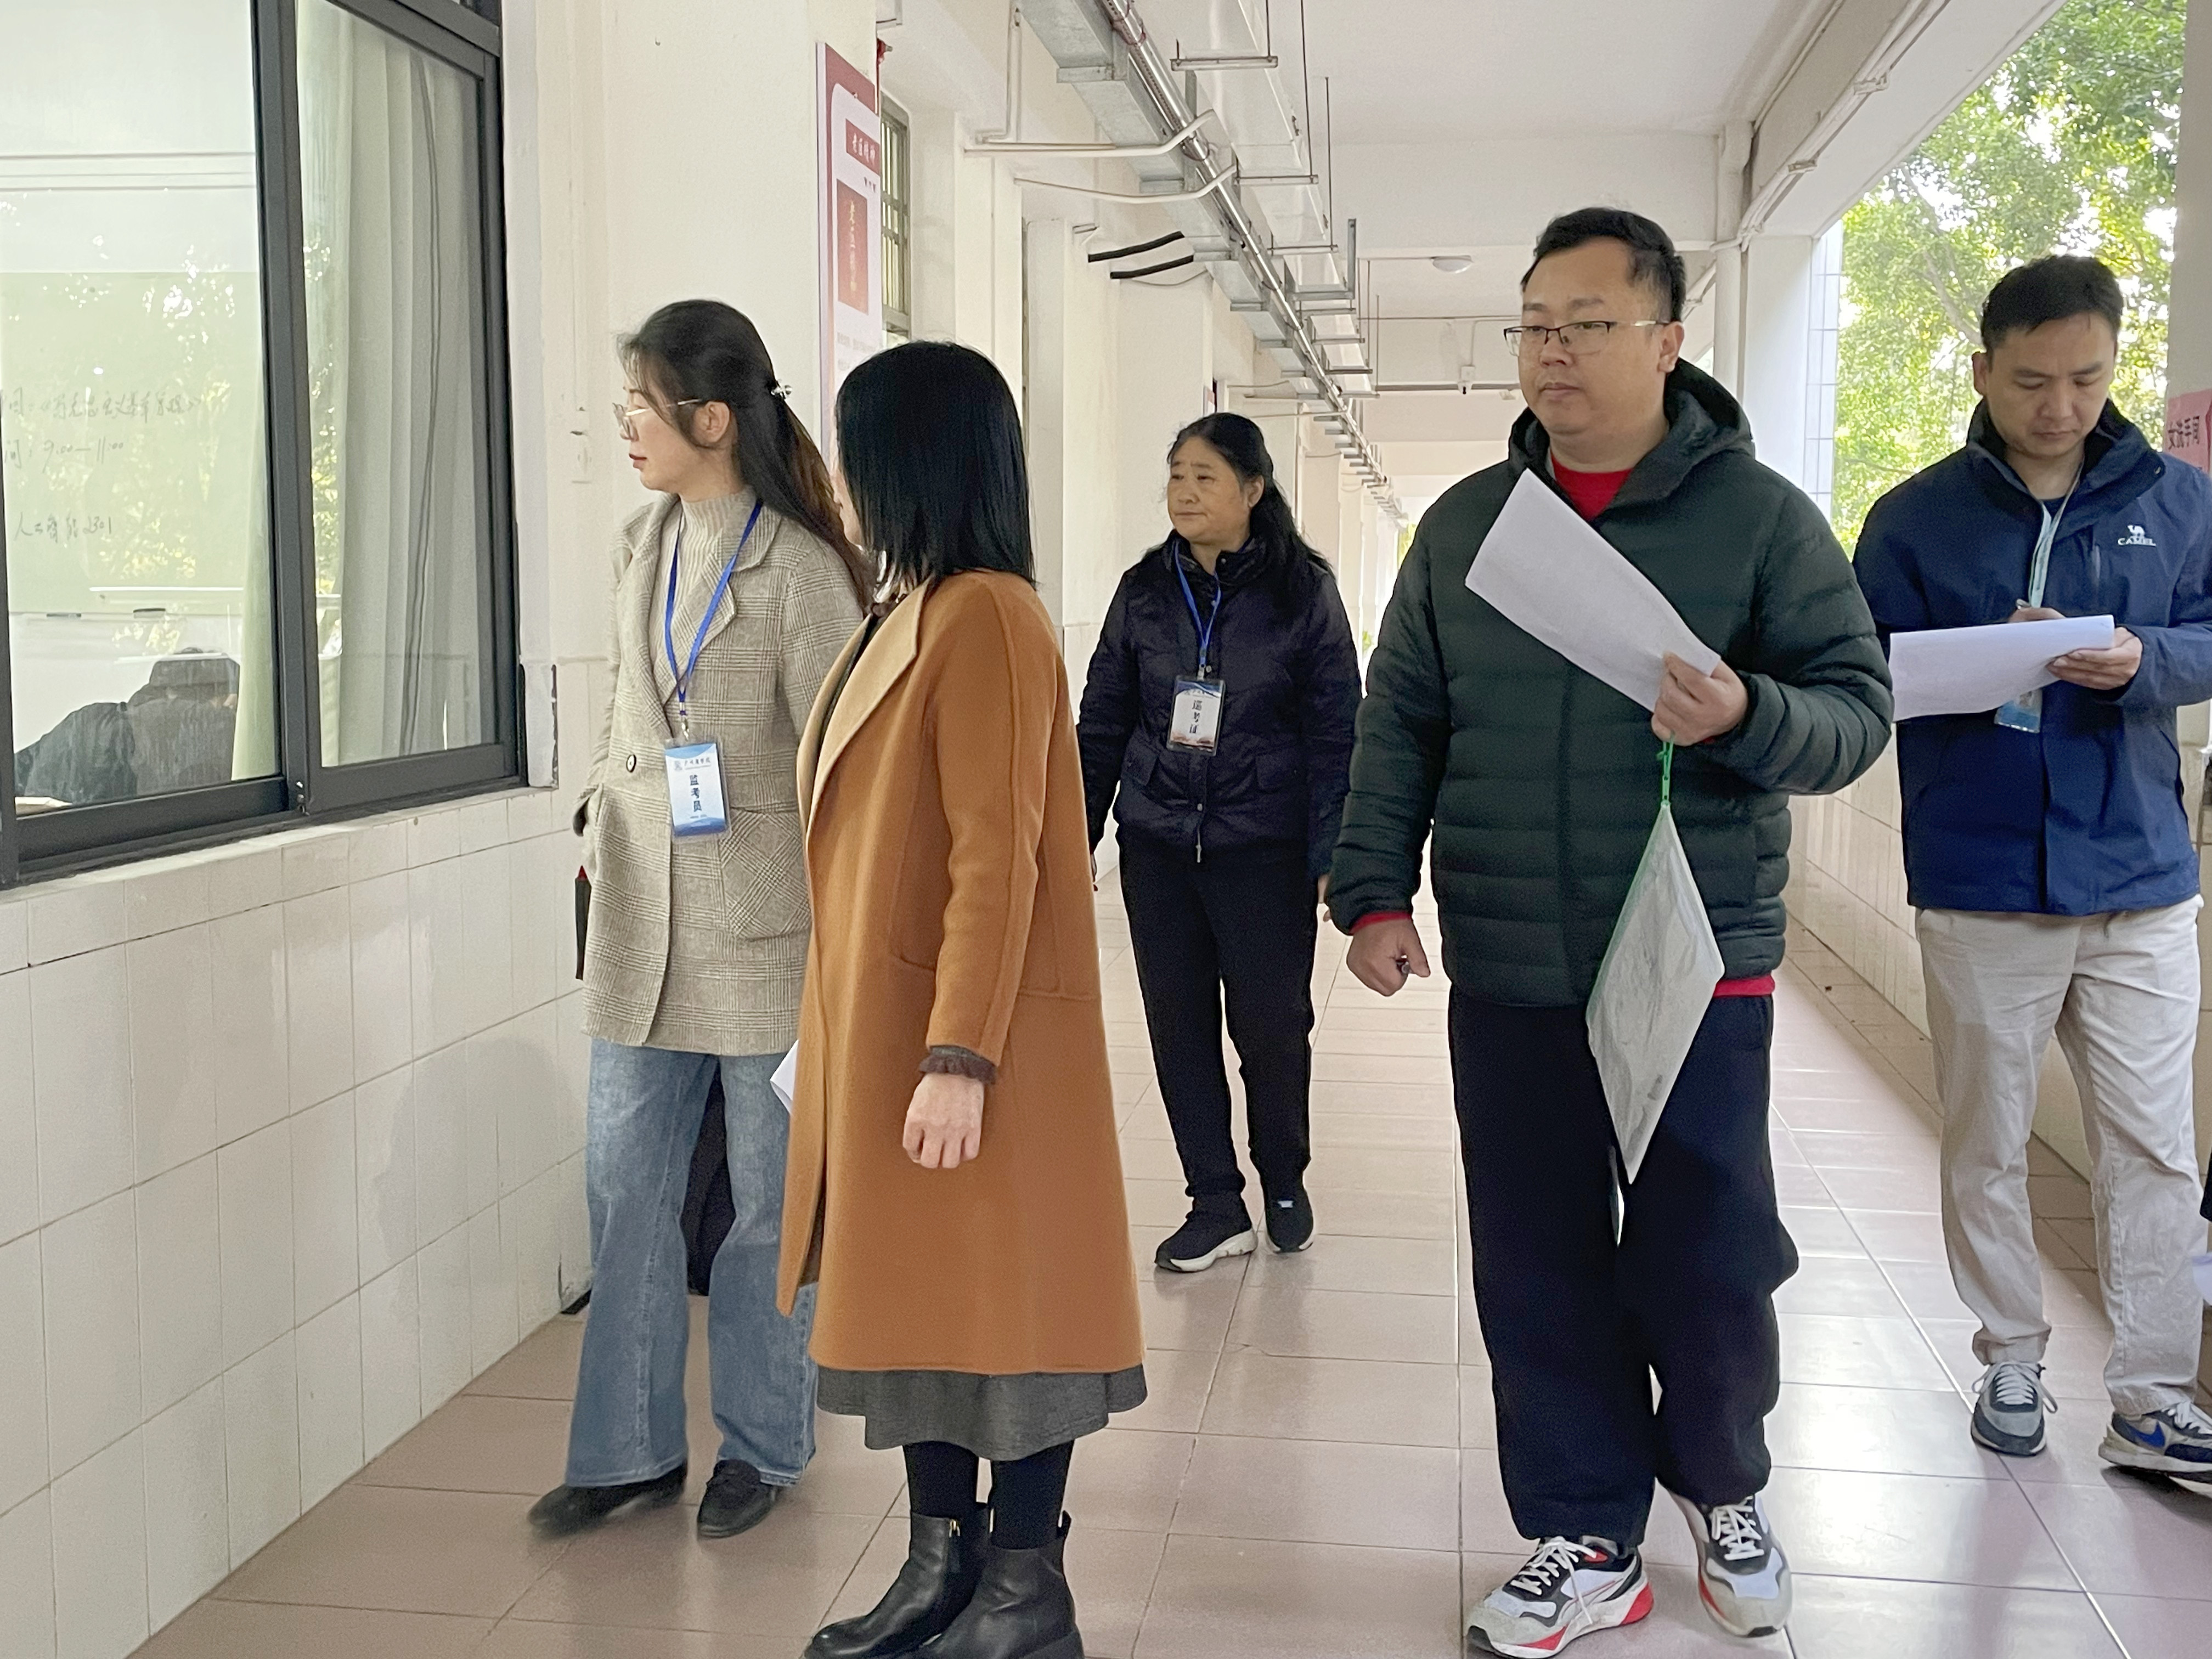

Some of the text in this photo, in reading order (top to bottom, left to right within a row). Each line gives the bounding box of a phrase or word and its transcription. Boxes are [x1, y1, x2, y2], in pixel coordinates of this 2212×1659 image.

[2118, 537, 2156, 546] CAMEL
[690, 775, 702, 812] 监考员
